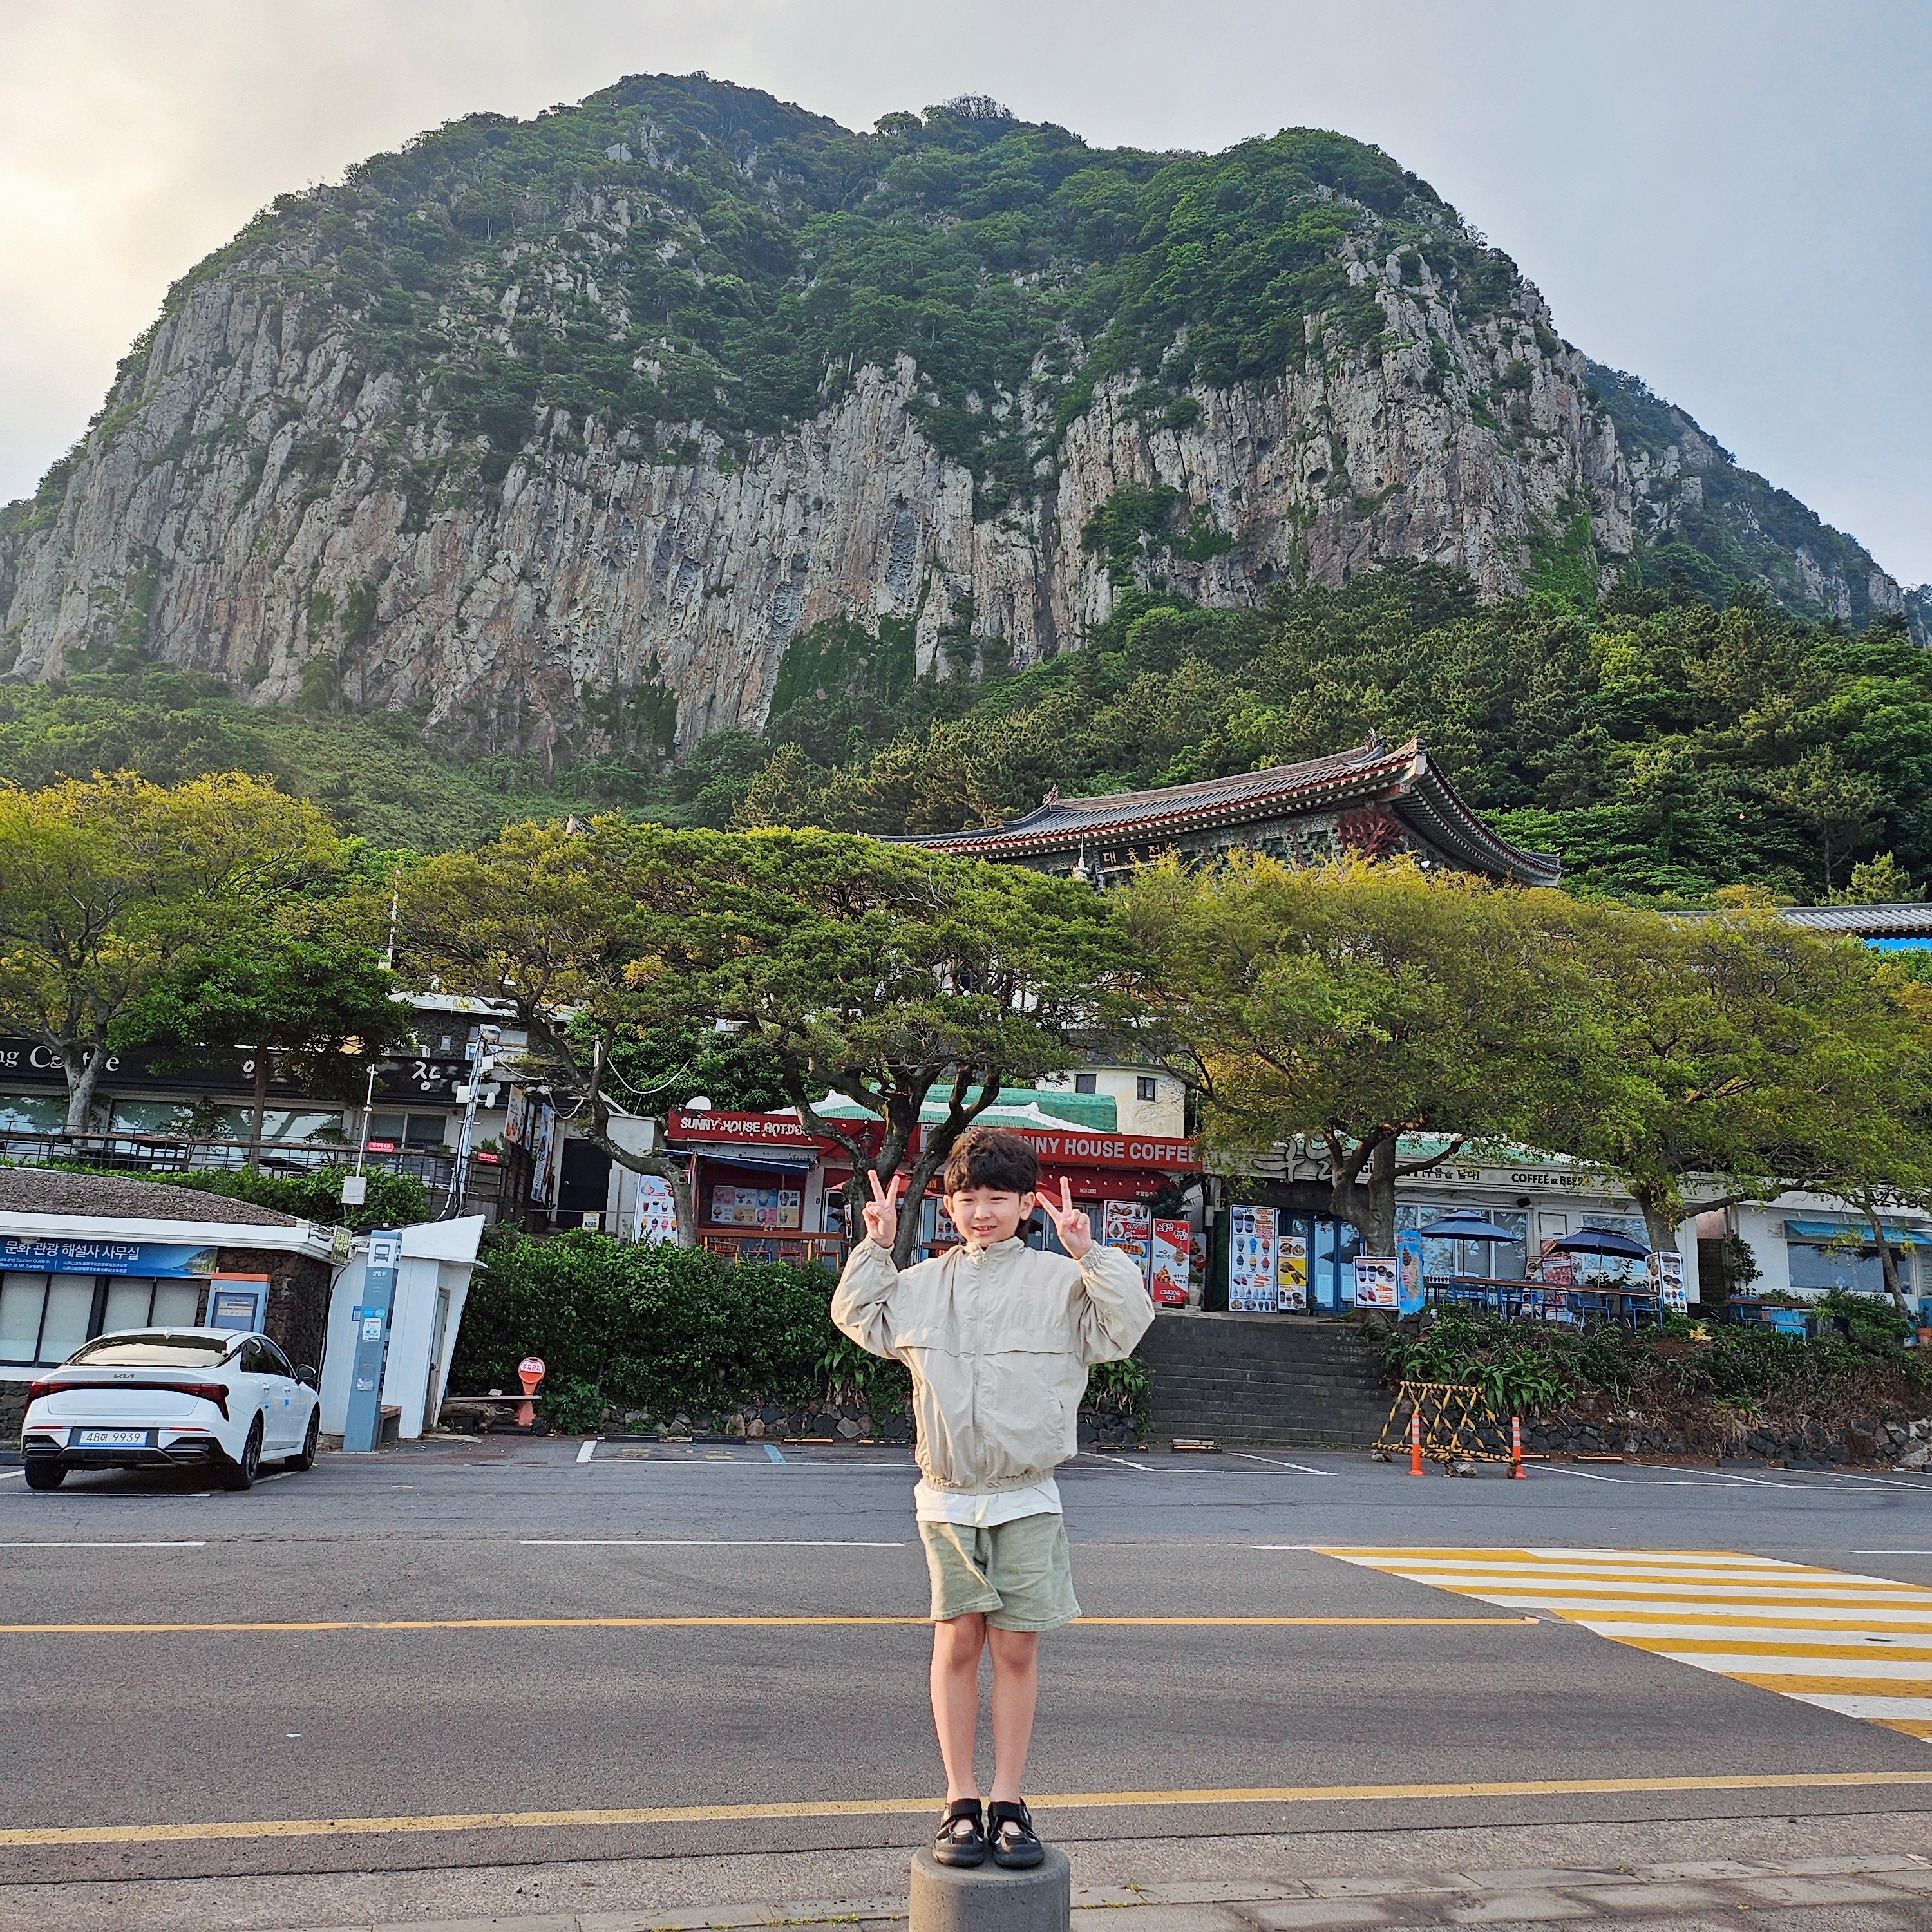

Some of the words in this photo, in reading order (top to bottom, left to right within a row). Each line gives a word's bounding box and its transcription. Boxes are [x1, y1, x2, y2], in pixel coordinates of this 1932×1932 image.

[1102, 845, 1160, 864] 대웅전
[680, 1117, 719, 1130] SUNNY
[722, 1120, 761, 1133] HOUSE
[1065, 1139, 1125, 1159] HOUSE
[1511, 1173, 1549, 1184] COFFEE
[5, 1240, 31, 1255] 문화
[33, 1242, 59, 1256] 관광
[62, 1243, 100, 1259] 해설사
[102, 1245, 140, 1261] 사무실
[113, 1432, 141, 1443] 9939
